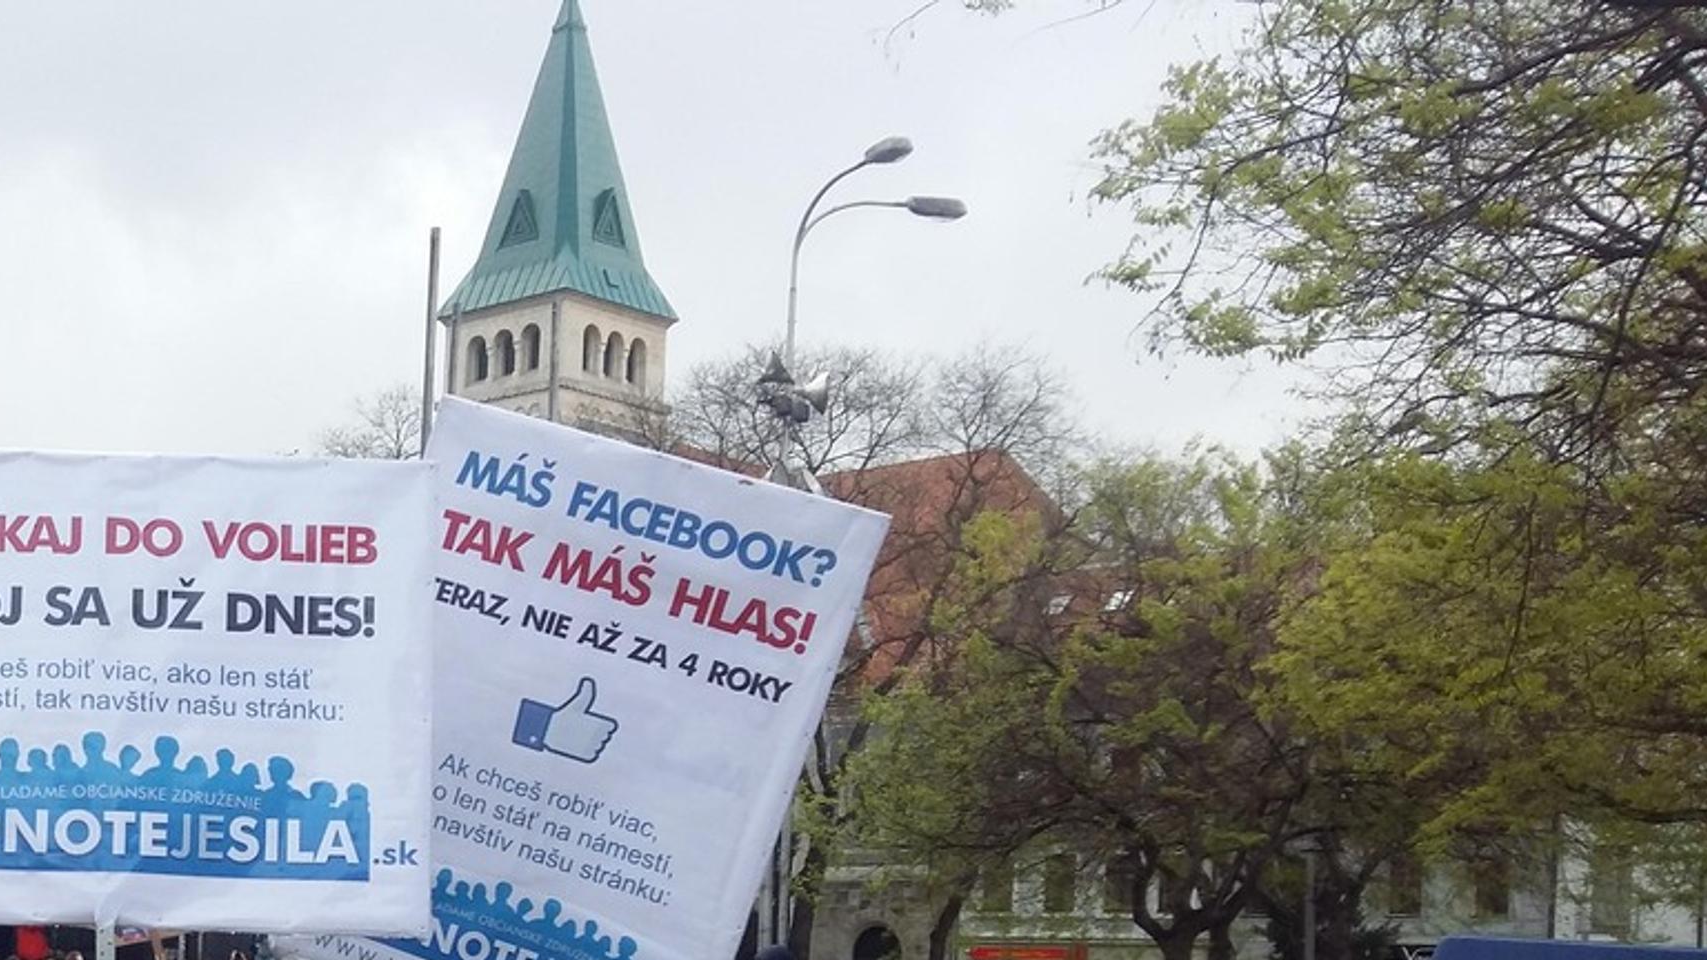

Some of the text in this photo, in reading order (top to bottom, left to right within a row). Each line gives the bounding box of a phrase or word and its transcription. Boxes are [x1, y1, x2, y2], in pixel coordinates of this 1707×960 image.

[105, 516, 183, 557] DO
[202, 520, 378, 564] VOLIEB
[455, 450, 837, 587] MÁŠ FACEBOOK?
[44, 586, 110, 626] SA
[132, 577, 205, 630] UŽ
[226, 593, 375, 638] DNES!
[442, 509, 818, 655] TAK MÁŠ HLAS!
[36, 658, 95, 679] robiť
[101, 660, 157, 684] viac,
[167, 663, 212, 686] ako
[220, 665, 256, 687] len
[264, 667, 313, 690] stáť
[521, 605, 573, 639] NIE
[577, 621, 623, 654] AŽ
[627, 636, 667, 669] ZA
[679, 653, 699, 677] 4
[708, 660, 793, 704] ROKY
[35, 689, 72, 709] tak
[81, 691, 169, 713] navštív
[178, 695, 236, 717] našu
[245, 698, 344, 721] stránku:
[432, 784, 674, 879] o len stáť na námestí,
[439, 753, 658, 843] Ak chceš robiť viac,
[433, 815, 672, 907] navštív našu stránku:
